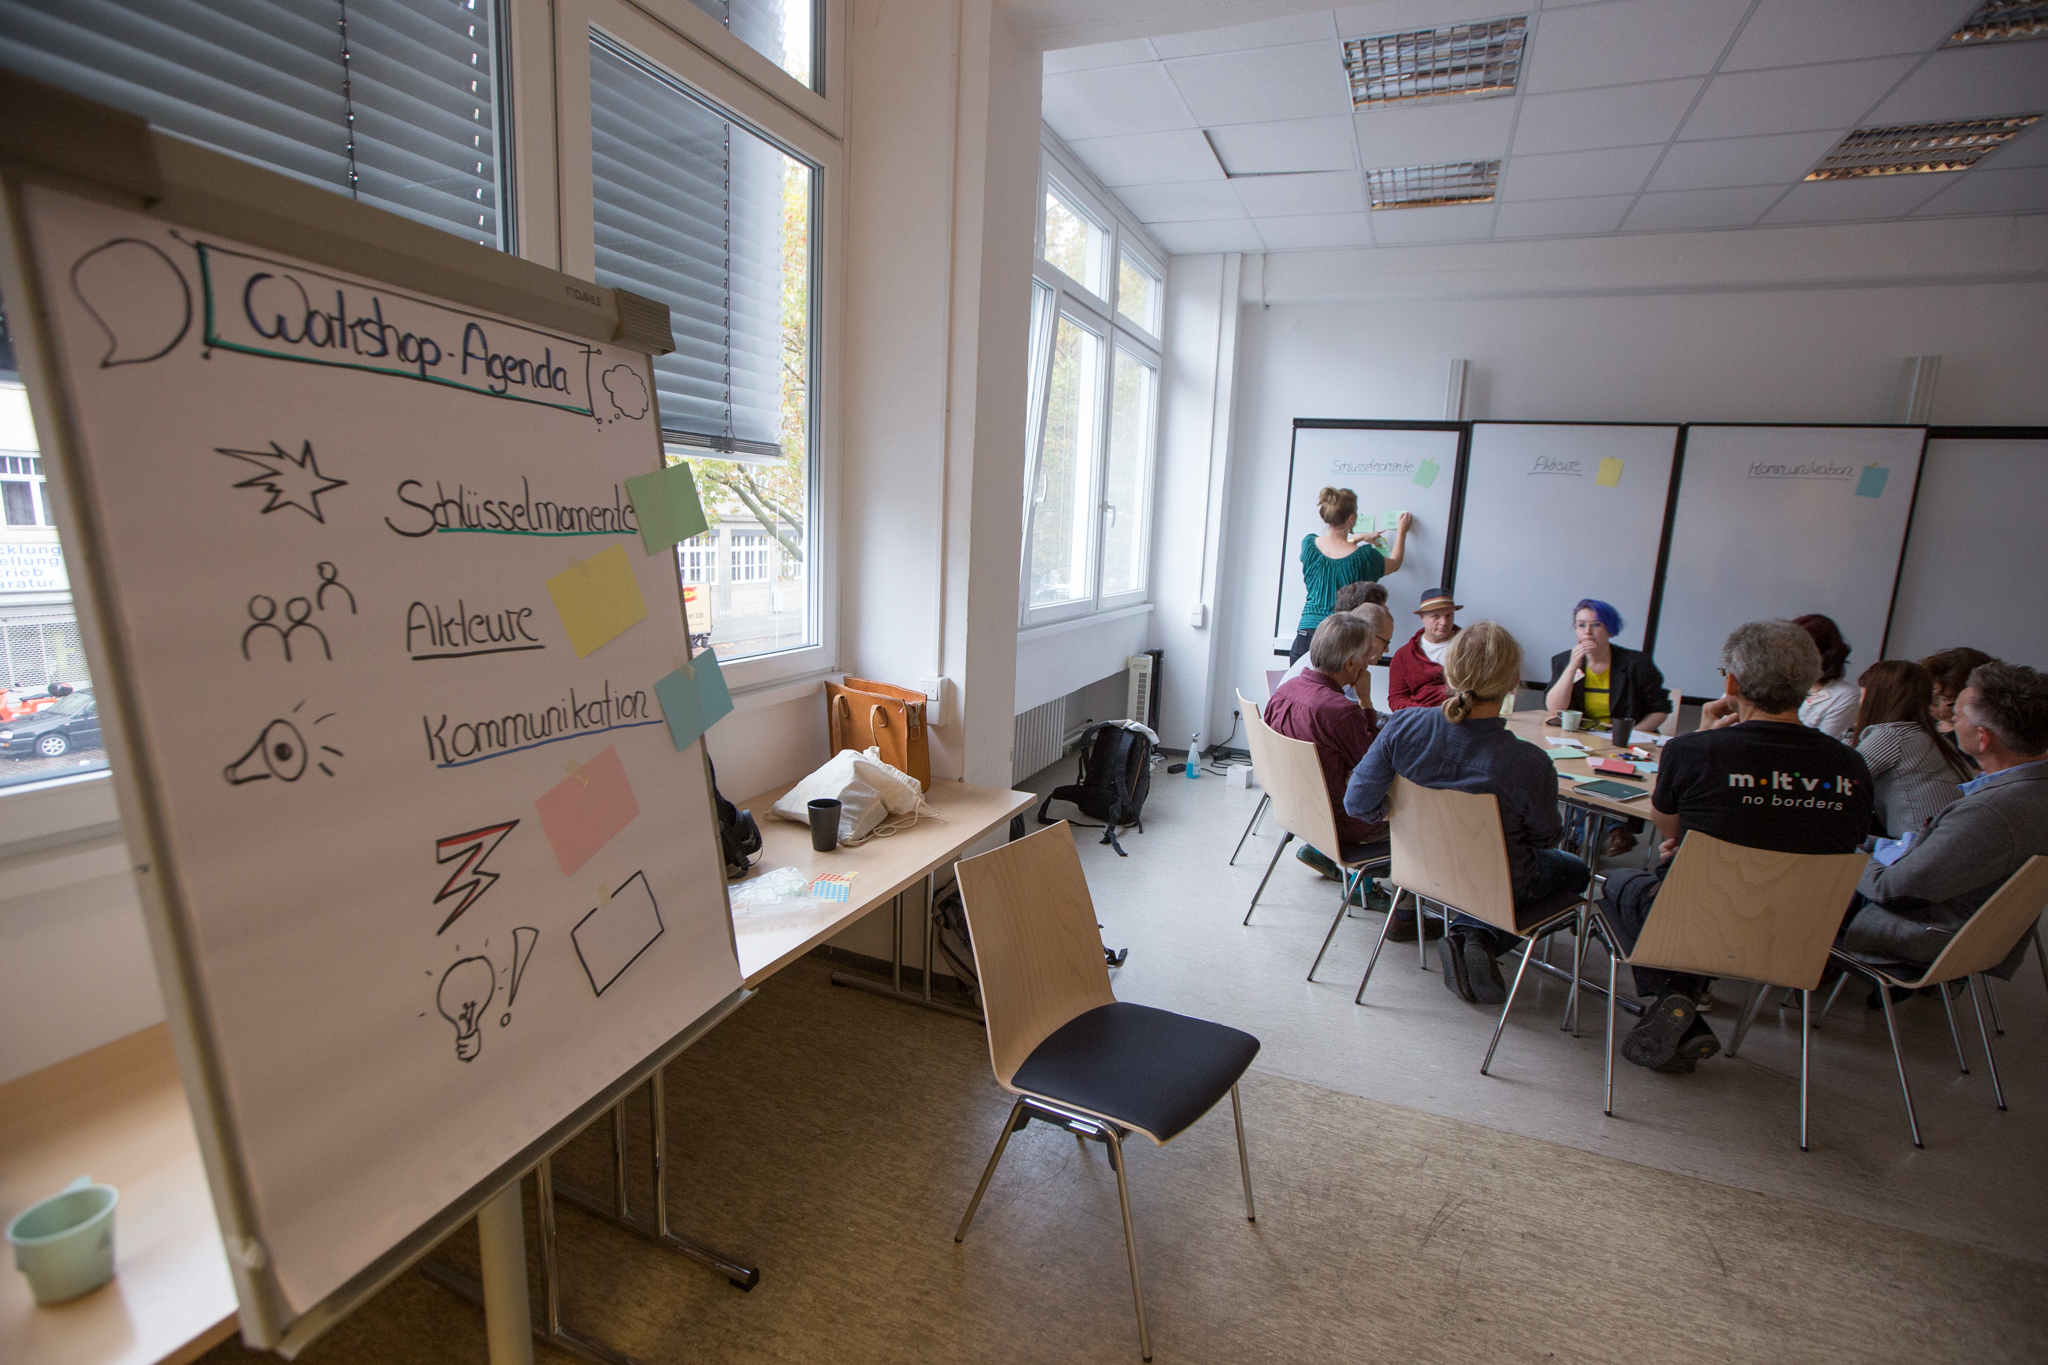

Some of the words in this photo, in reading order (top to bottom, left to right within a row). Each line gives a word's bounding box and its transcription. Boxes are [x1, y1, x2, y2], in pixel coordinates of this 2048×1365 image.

[384, 475, 638, 537] Schlüsselmomente
[406, 599, 540, 652] Akteure
[422, 680, 650, 764] Kommunikation
[1742, 794, 1764, 805] no
[1771, 794, 1844, 811] borders
